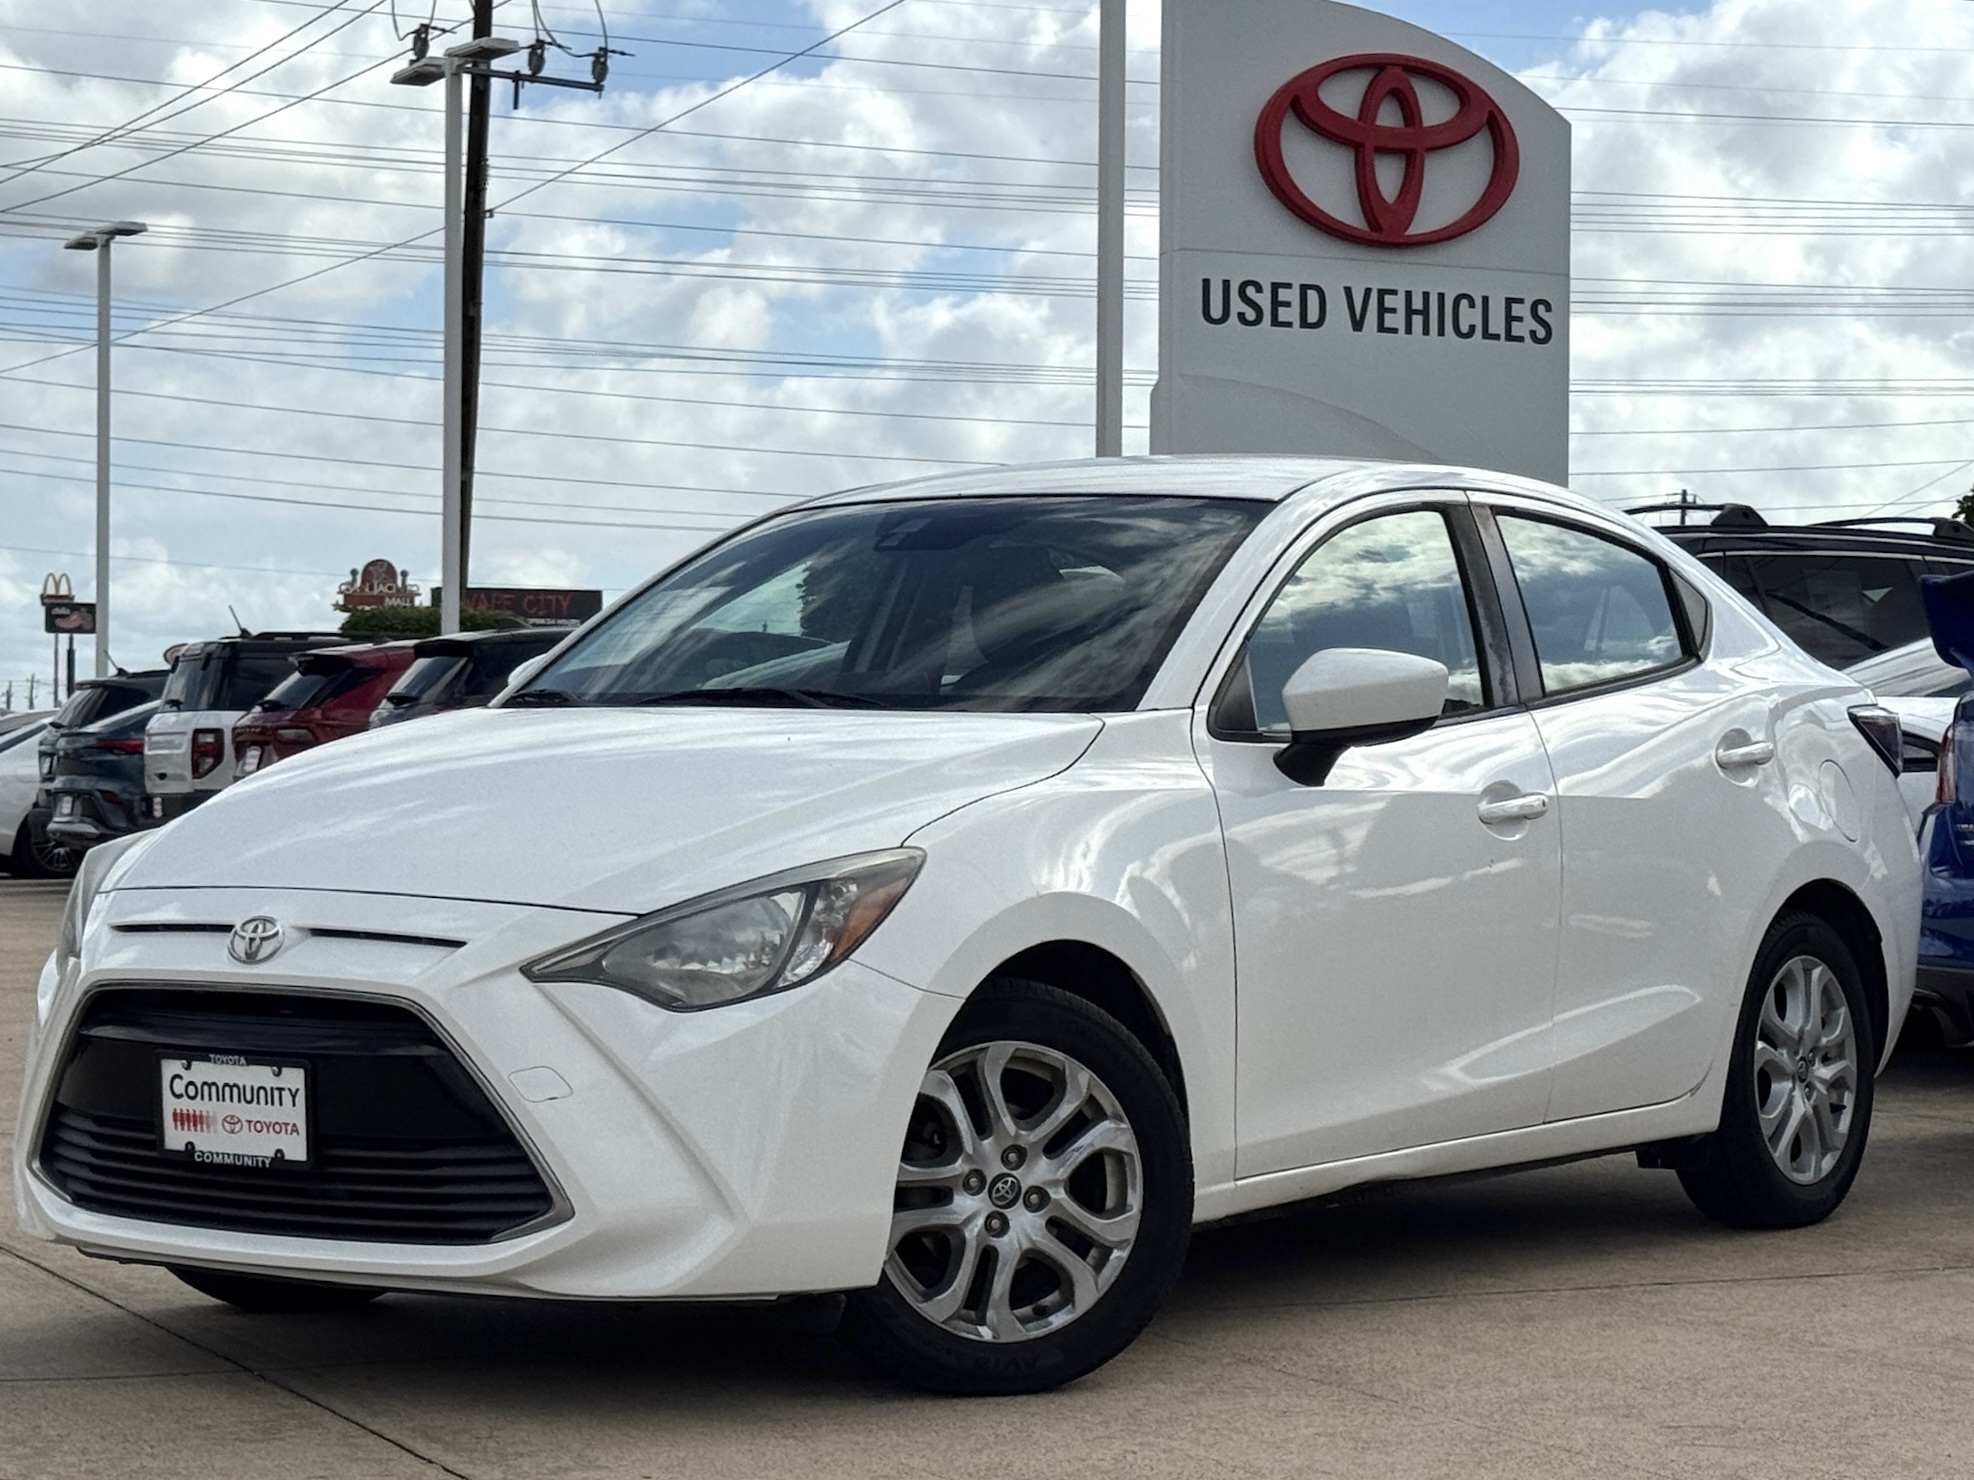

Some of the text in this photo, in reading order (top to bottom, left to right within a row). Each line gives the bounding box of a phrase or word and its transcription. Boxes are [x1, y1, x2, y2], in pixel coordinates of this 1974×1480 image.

[1201, 278, 1554, 346] USED VEHICLES
[523, 592, 573, 616] CITY
[208, 1053, 248, 1067] TOYOTA
[245, 1119, 301, 1137] TOYOTA
[193, 1150, 273, 1168] COMMUNITY
